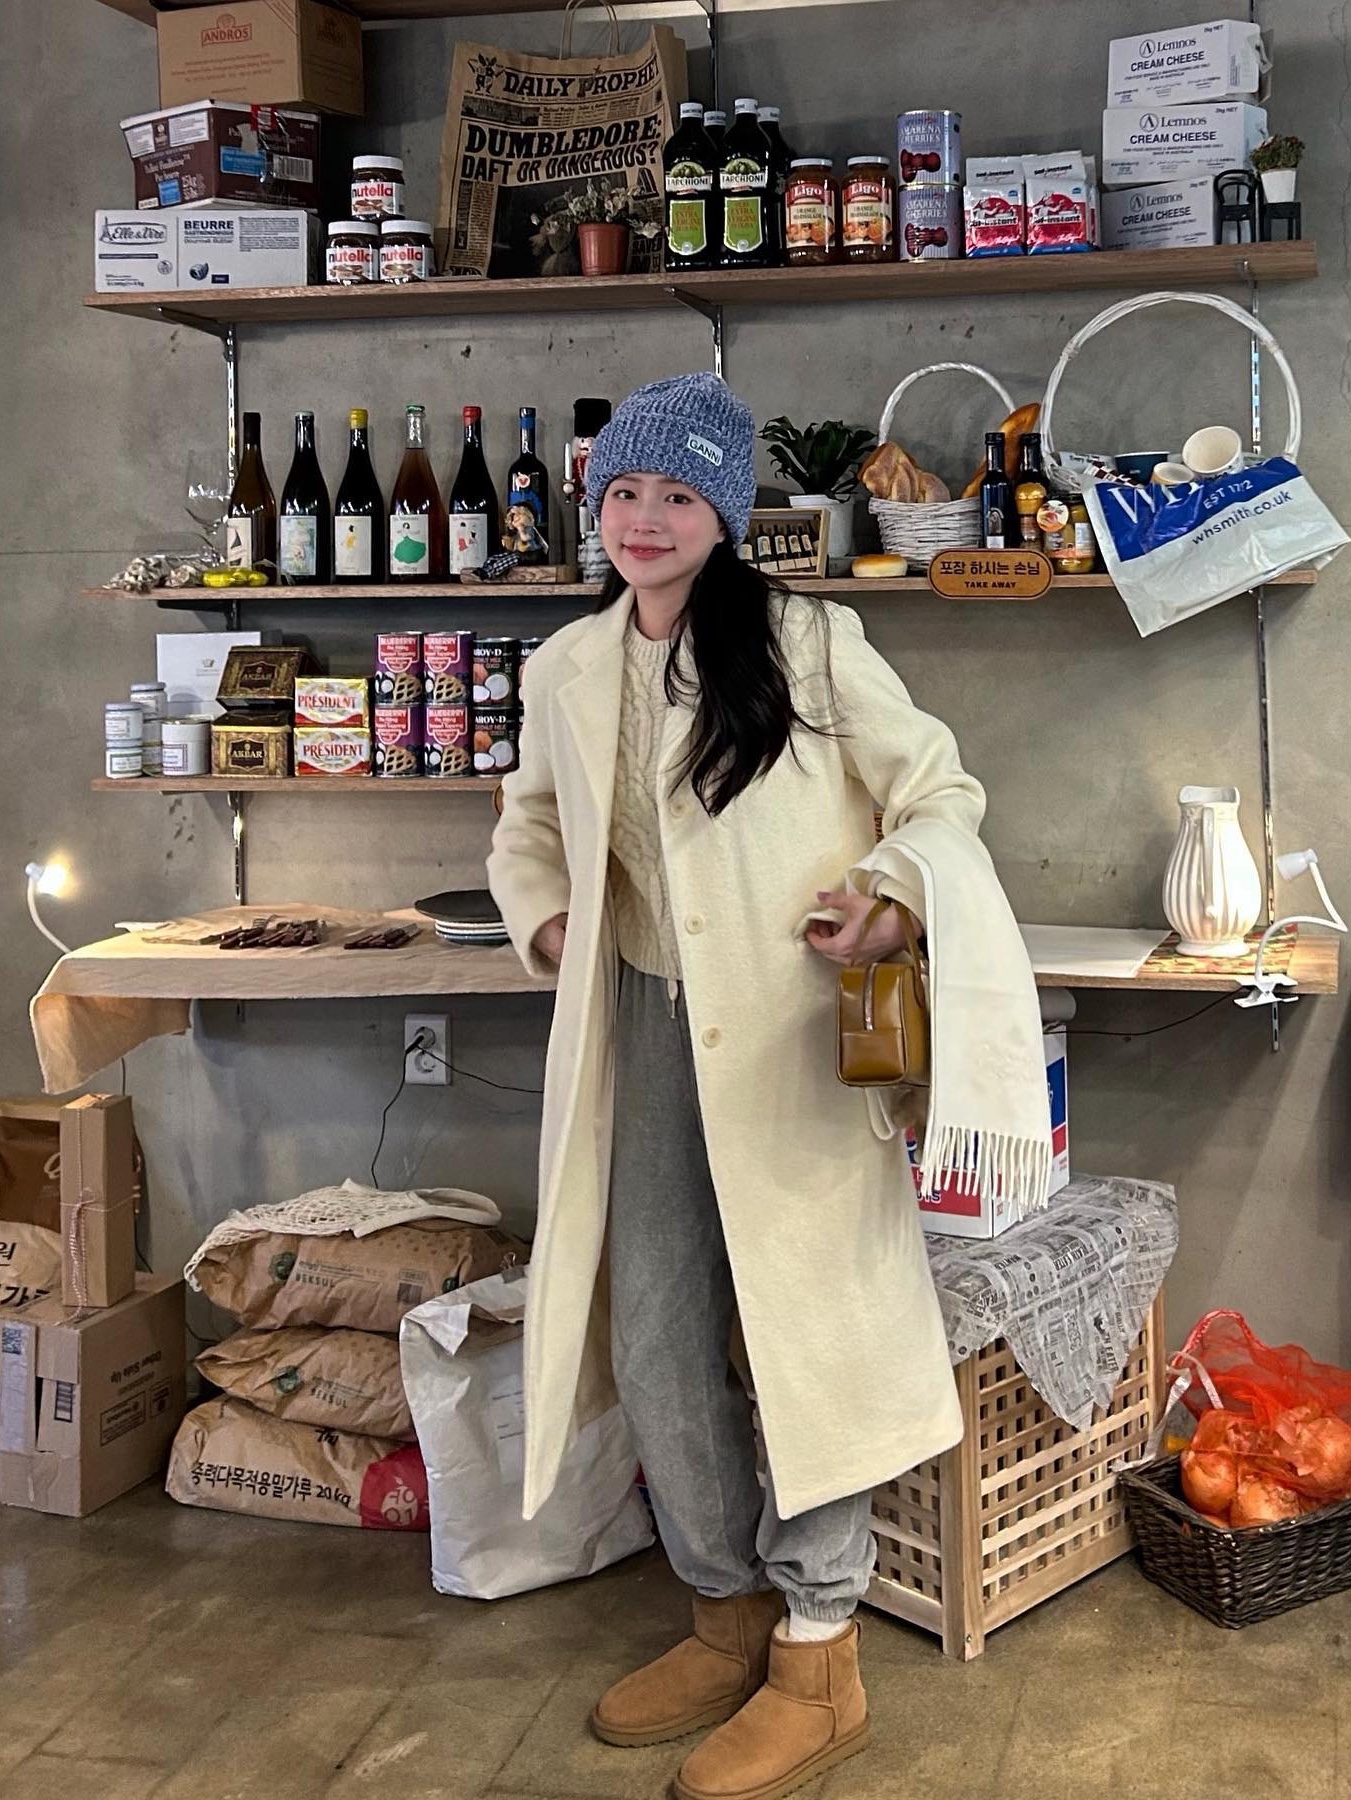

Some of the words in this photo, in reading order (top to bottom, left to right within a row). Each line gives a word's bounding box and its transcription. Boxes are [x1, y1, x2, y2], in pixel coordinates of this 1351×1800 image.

[203, 28, 250, 42] ANDROS
[1157, 38, 1197, 53] Lemnos
[1130, 58, 1165, 72] CREAM
[1166, 50, 1205, 66] CHEESE
[502, 71, 576, 97] DAILY
[577, 58, 660, 98] PROPHET
[1160, 116, 1207, 128] Lemnos
[465, 114, 662, 159] DUMBLEDORE:
[1130, 134, 1169, 144] CREAM
[1172, 131, 1217, 142] CHEESE
[460, 154, 513, 184] DAFT
[516, 159, 542, 183] OR
[545, 140, 660, 179] DANGEROUS?
[352, 183, 394, 197] nutella
[793, 184, 823, 197] Ligo
[851, 182, 880, 195] Ligo
[1146, 193, 1184, 207] Lemnos
[1122, 211, 1154, 226] CREAM
[1155, 206, 1192, 221] CHEESE
[184, 220, 234, 230] BEURRE
[329, 249, 374, 263] nutella
[381, 248, 423, 262] nutella
[690, 439, 720, 464] GANNI
[1202, 487, 1226, 510] EST
[940, 561, 966, 575] 포장
[970, 561, 1009, 575] 하시는
[1014, 561, 1040, 576] 손님
[964, 581, 988, 589] TAKE
[991, 581, 1017, 589] AWAY
[242, 673, 272, 681] AKBAR
[232, 750, 263, 759] AKBAR
[303, 741, 363, 759] PRÉSIDENT
[122, 1361, 140, 1379] Side
[110, 1371, 122, 1385] Up
